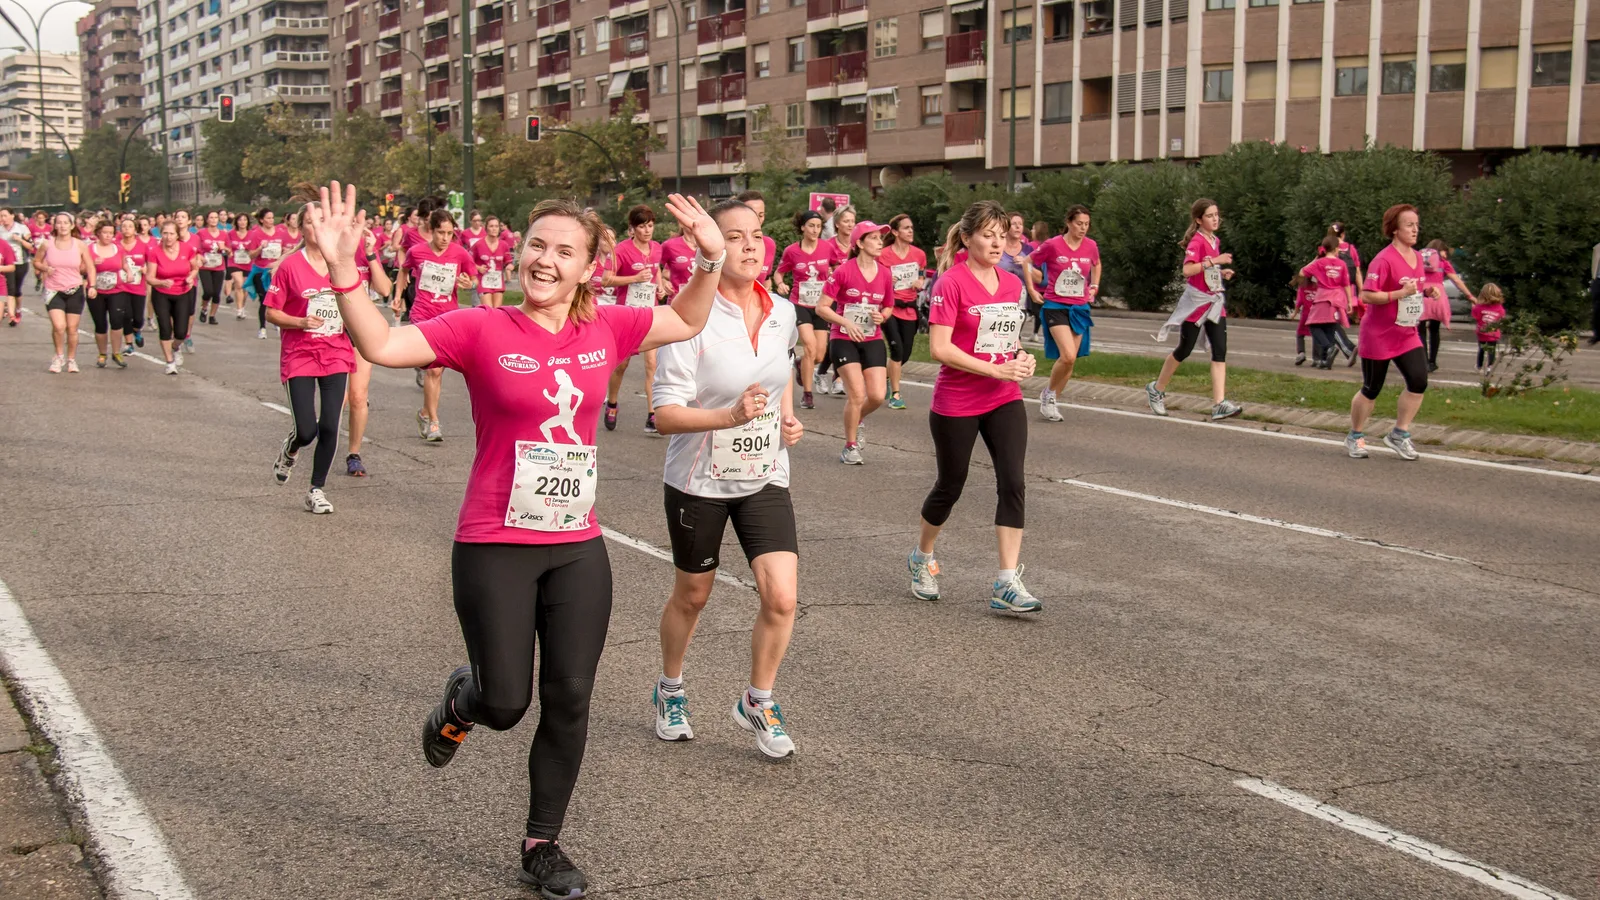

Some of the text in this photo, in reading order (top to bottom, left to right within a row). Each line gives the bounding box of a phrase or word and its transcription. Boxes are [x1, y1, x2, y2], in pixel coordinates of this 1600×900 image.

[315, 309, 338, 319] 6003
[853, 315, 869, 324] 714
[989, 320, 1016, 332] 4156
[553, 357, 571, 365] asics
[577, 348, 606, 364] DKV
[732, 434, 770, 453] 5904
[567, 451, 588, 461] DKV
[534, 476, 580, 497] 2208
